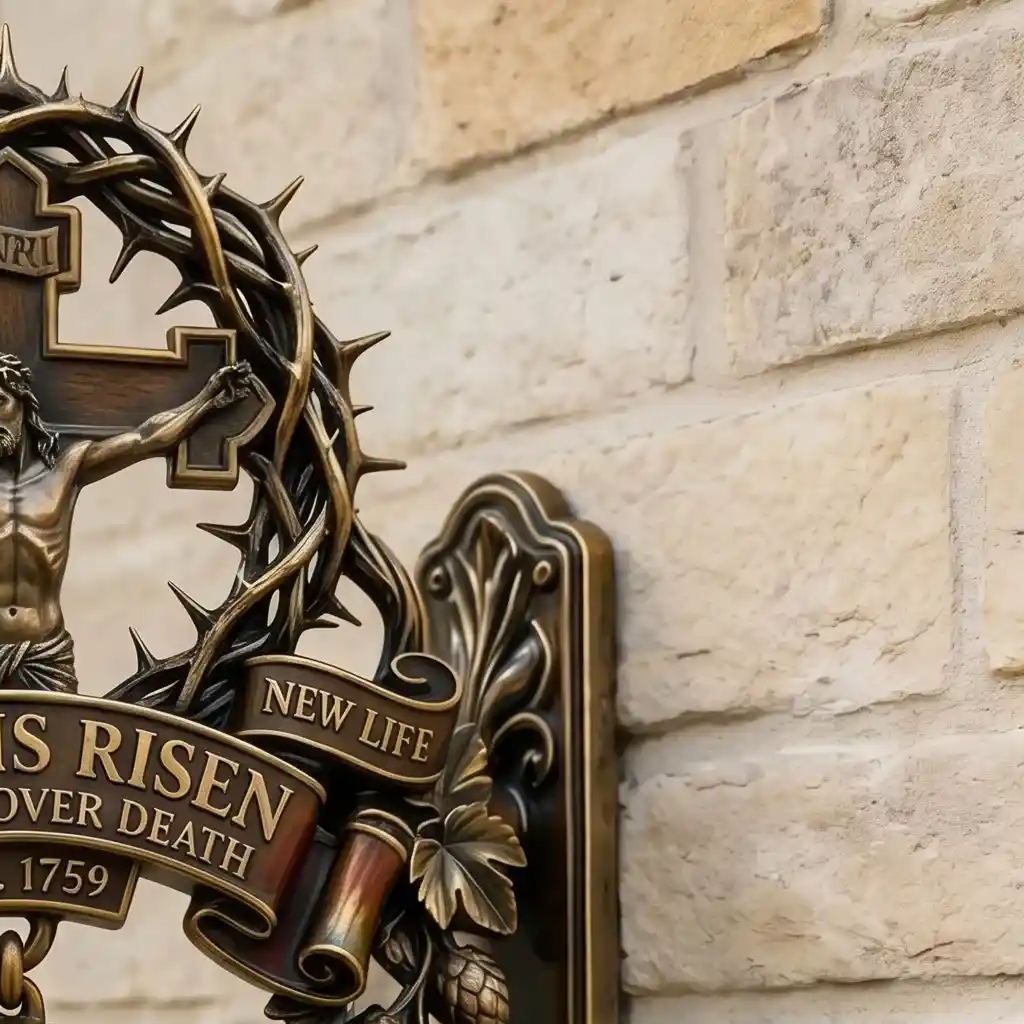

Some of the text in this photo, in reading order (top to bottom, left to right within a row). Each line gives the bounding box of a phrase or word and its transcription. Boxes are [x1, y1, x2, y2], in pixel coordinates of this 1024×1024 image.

[263, 677, 434, 763] NEW LIFE
[76, 719, 294, 842] RISEN
[21, 857, 109, 896] 1759
[117, 798, 255, 880] DEATH
